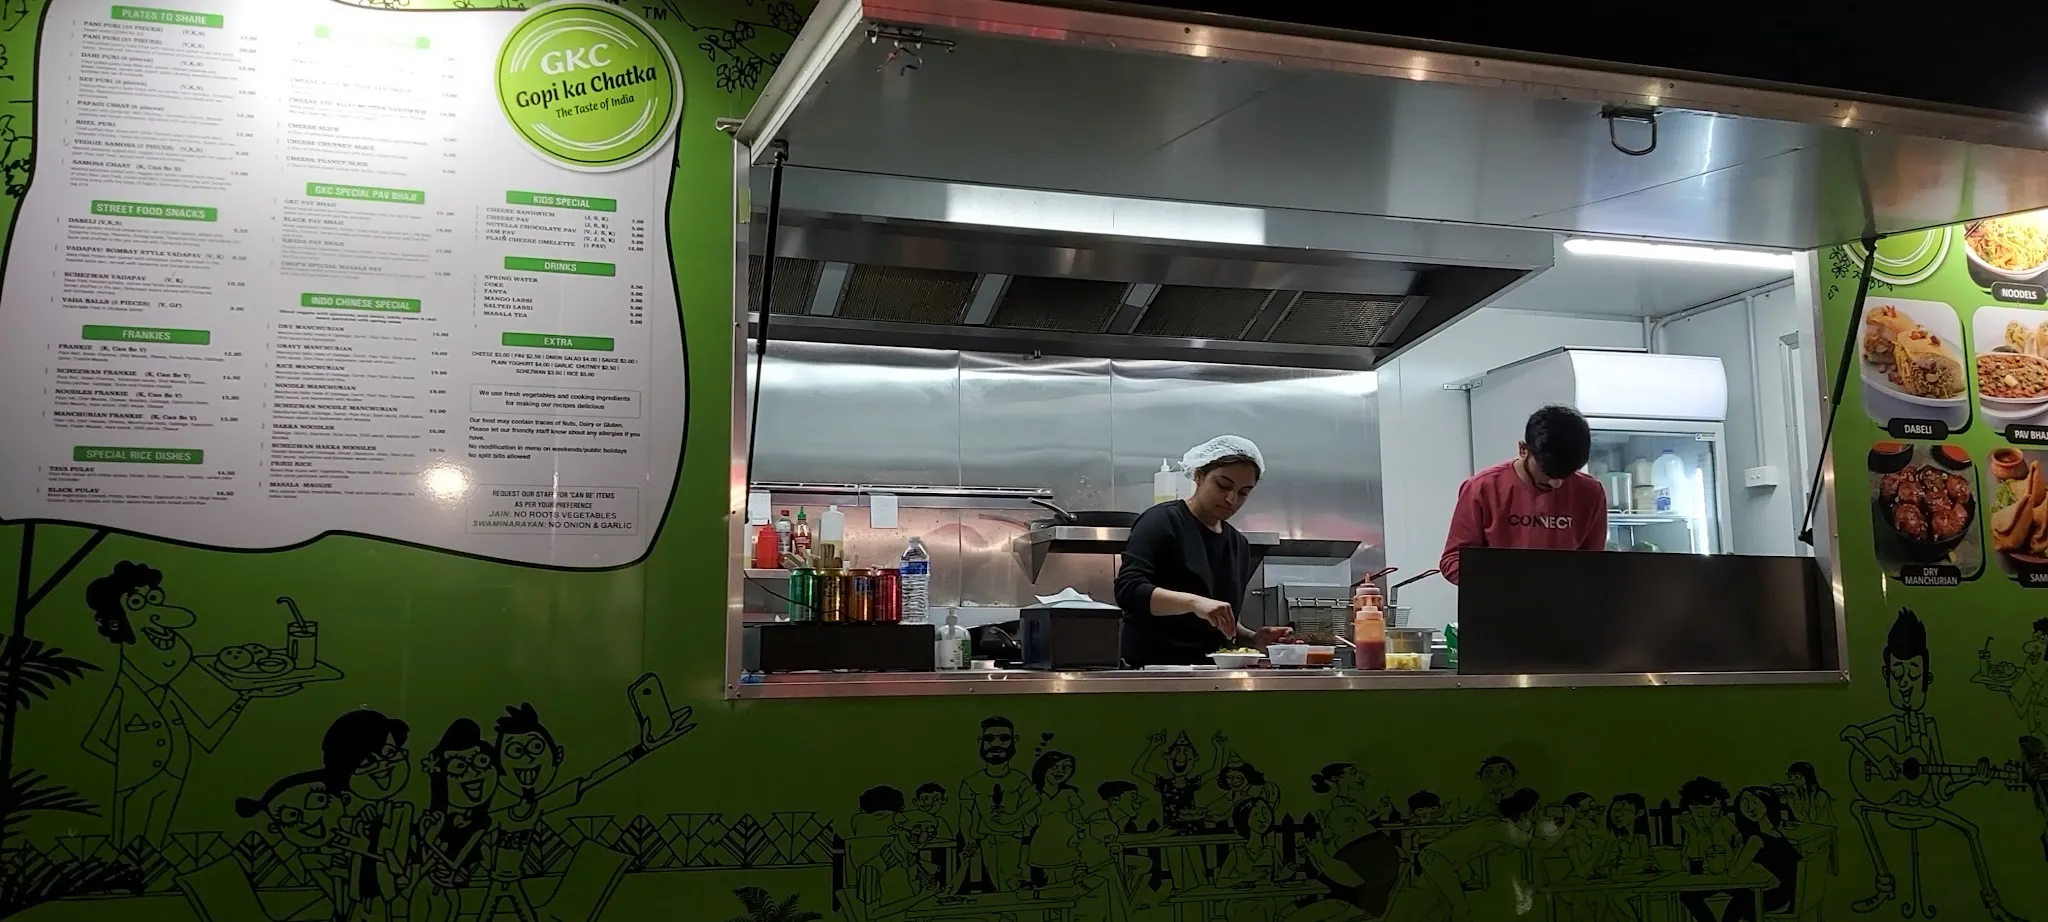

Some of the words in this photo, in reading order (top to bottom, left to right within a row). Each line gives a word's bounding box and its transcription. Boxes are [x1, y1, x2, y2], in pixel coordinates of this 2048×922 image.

[122, 9, 158, 20] PLATES
[160, 12, 173, 22] TO
[175, 13, 207, 25] SHARE
[642, 5, 667, 21] TM
[540, 43, 611, 75] GKC
[516, 83, 559, 109] Gopi
[563, 80, 586, 99] ka
[590, 65, 657, 93] Chatka
[556, 107, 573, 119] The
[574, 102, 599, 115] Taste
[600, 99, 609, 110] of
[611, 95, 635, 107] India
[315, 186, 334, 195] GKC
[335, 187, 370, 198] SPECIAL
[372, 189, 390, 199] PAV
[391, 190, 417, 201] BHAJI
[533, 195, 554, 205] KIDS
[555, 197, 591, 208] SPECIAL
[96, 203, 134, 215] STREET
[136, 206, 163, 217] FOOD
[165, 208, 205, 219] SNACKS
[516, 210, 555, 218] SANDWICH
[486, 214, 514, 222] CHEESE
[520, 224, 562, 233] CHOCOLATE
[538, 239, 576, 247] OMELETTE
[544, 262, 577, 272] DRINKS
[2001, 287, 2038, 300] NOODELS
[311, 296, 334, 306] INDO
[335, 298, 372, 308] CHINESE
[375, 300, 410, 310] SPECIAL
[122, 330, 171, 340] FRANKIES
[544, 337, 573, 347] EXTRA
[504, 390, 521, 398] fresh
[522, 391, 556, 400] vegetables
[557, 392, 569, 400] and
[570, 393, 595, 401] cooking
[596, 394, 631, 402] ingredients
[516, 400, 539, 408] making
[552, 402, 576, 410] recipes
[482, 417, 496, 425] food
[511, 418, 533, 426] contain
[579, 421, 594, 429] Dairy
[1904, 423, 1933, 435] DABELI
[2014, 429, 2031, 440] PAV
[478, 443, 516, 451] modification
[552, 445, 601, 454] weekends/public
[86, 450, 127, 460] SPECIAL
[130, 451, 153, 460] RICE
[155, 452, 192, 461] DISHES
[478, 452, 492, 460] split
[538, 501, 554, 509] YOUR
[555, 501, 593, 509] PREFERENCE
[529, 511, 560, 519] ROOTS
[561, 511, 617, 519] VEGETABLES
[472, 520, 547, 528] SWAMINARAYAN:
[564, 521, 591, 529] ONION
[600, 521, 632, 529] GARLIC
[1507, 513, 1573, 529] CONNECT
[1923, 567, 1939, 577] DRY
[1905, 575, 1958, 586] MANCHURIAN
